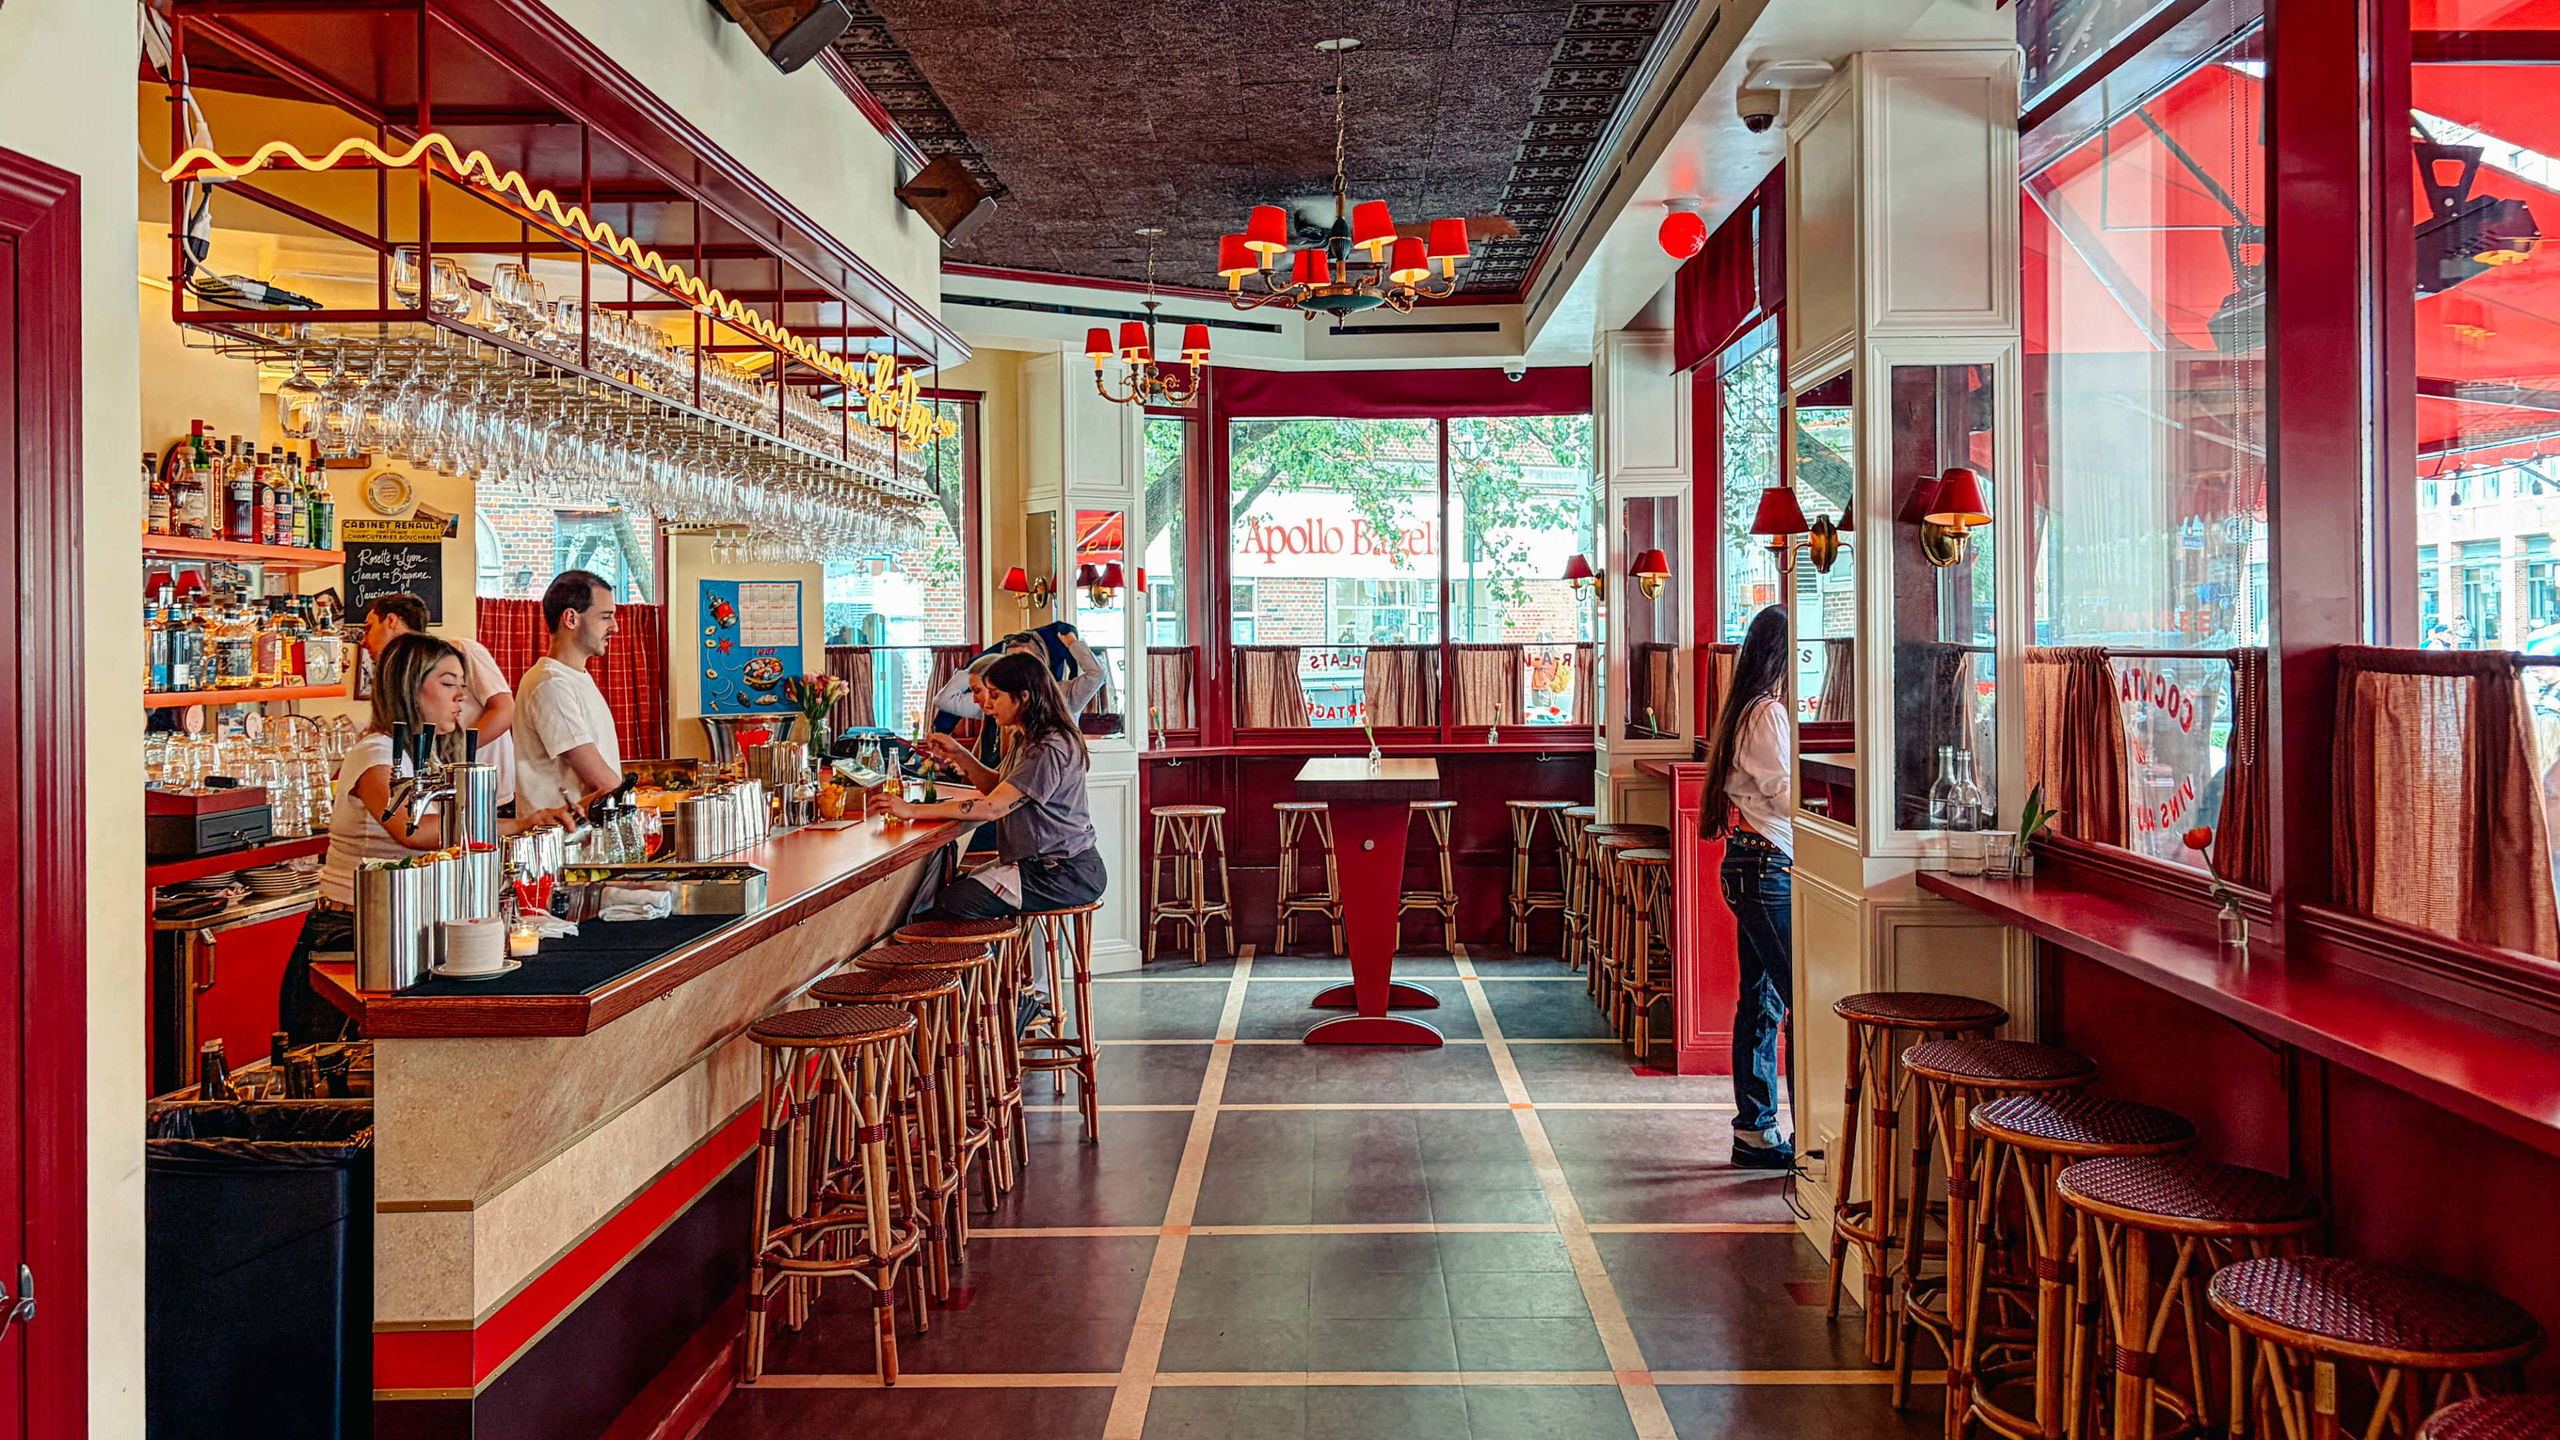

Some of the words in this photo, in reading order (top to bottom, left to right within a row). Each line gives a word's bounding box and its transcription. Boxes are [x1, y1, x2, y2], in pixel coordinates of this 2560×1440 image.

[343, 521, 391, 530] CABINET
[395, 521, 440, 530] RENAULT
[399, 534, 441, 542] BOUCHERIES
[1240, 517, 1344, 564] Apollo
